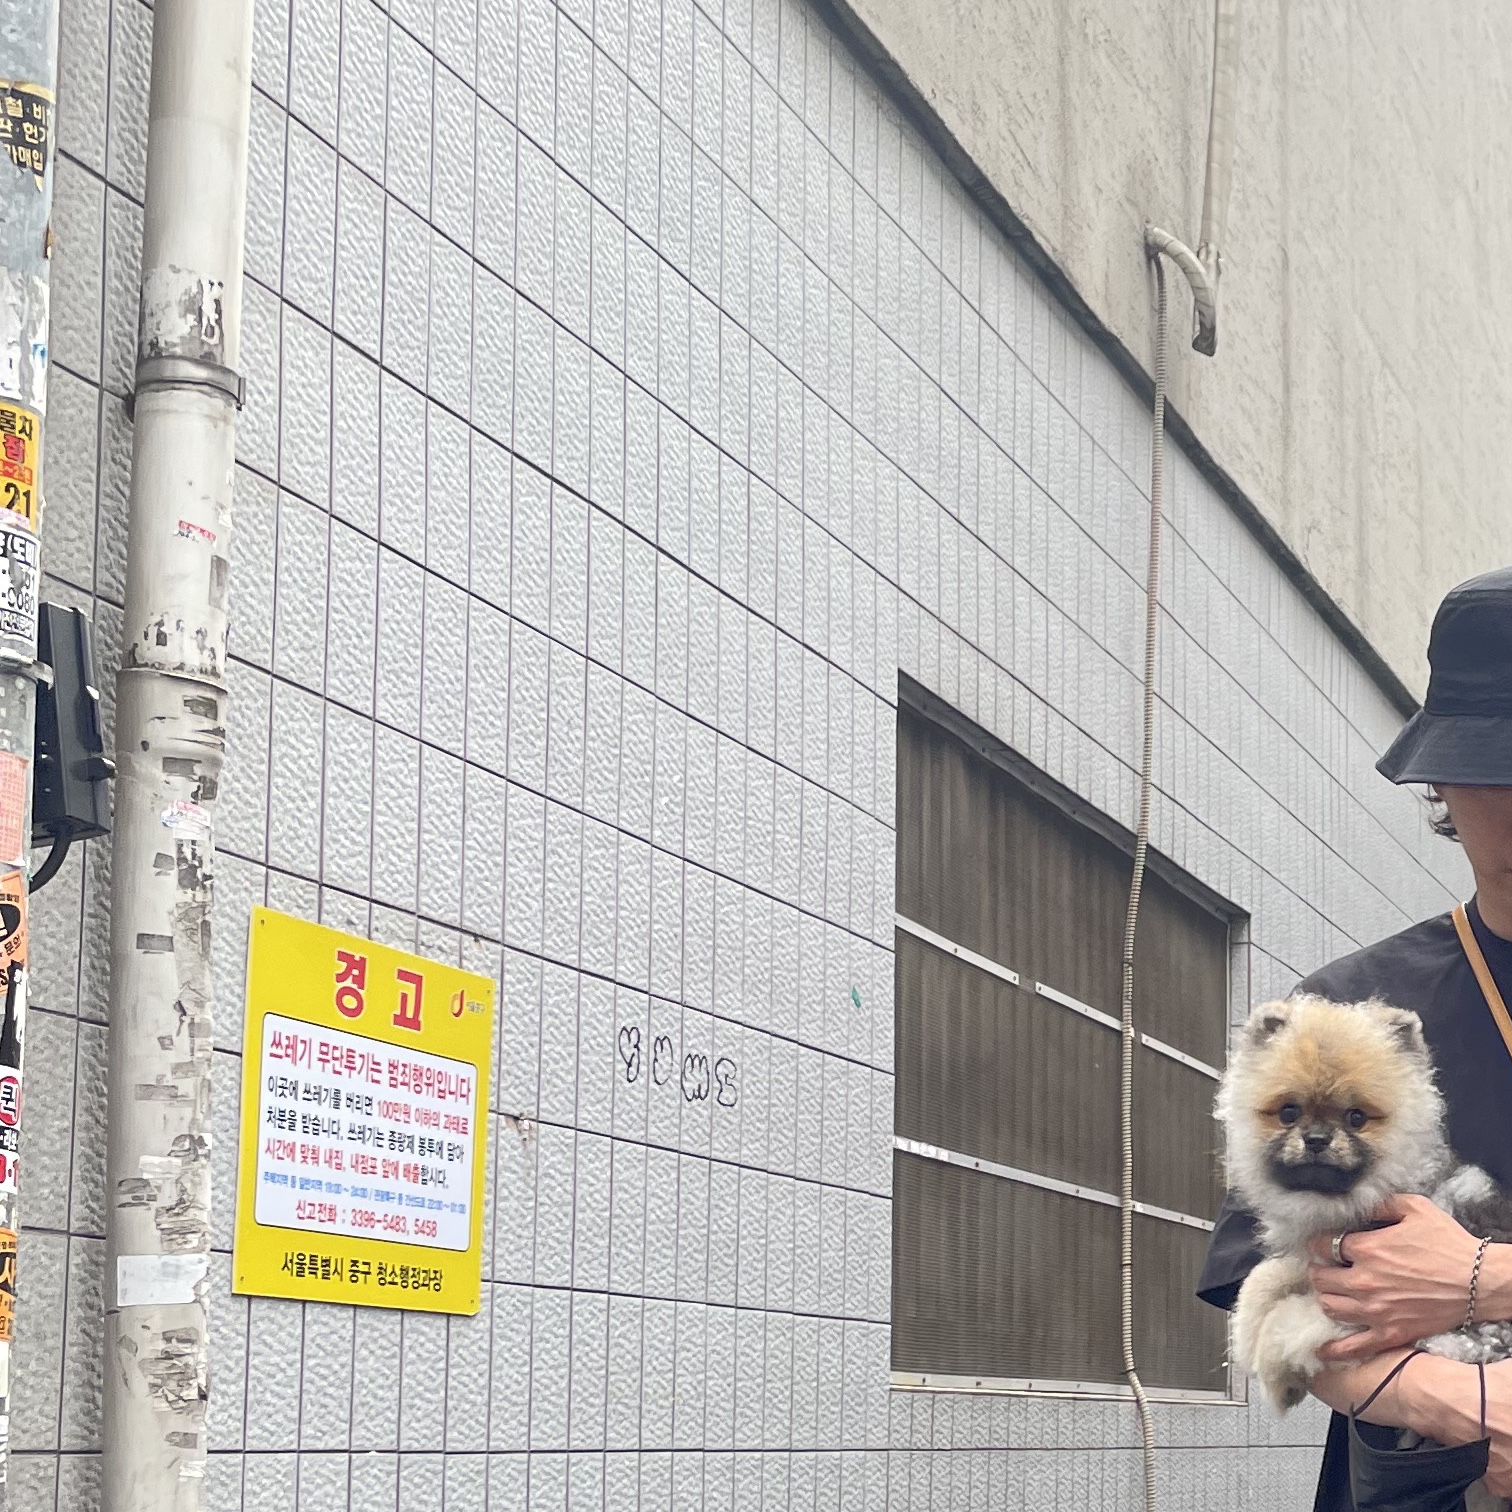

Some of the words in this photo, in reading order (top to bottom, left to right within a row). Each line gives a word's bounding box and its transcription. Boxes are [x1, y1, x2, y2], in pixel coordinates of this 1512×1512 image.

[335, 950, 367, 1018] 경
[393, 968, 423, 1031] 고
[269, 1030, 312, 1069] 쓰레기
[316, 1041, 383, 1085] 무단투기는
[388, 1057, 471, 1106] 범죄행위입니다
[268, 1075, 298, 1101] 이곳에
[302, 1082, 341, 1110] 쓰레기를
[345, 1091, 373, 1117] 버리면
[377, 1099, 411, 1125] 100만원
[414, 1107, 440, 1132] 이하의
[265, 1137, 296, 1162] 시간에
[266, 1105, 297, 1132] 처분을
[301, 1112, 344, 1140] 받습니다.
[347, 1122, 385, 1149] 쓰레기는
[388, 1130, 415, 1154] 종량제
[418, 1136, 443, 1159] 봉투에
[447, 1142, 465, 1164] 담아
[296, 1199, 337, 1225] 신고전화
[414, 1218, 438, 1238] 5458
[281, 1251, 345, 1282] 서울특별시
[348, 1259, 372, 1285] 중구
[377, 1261, 443, 1292] 청소행정과장
